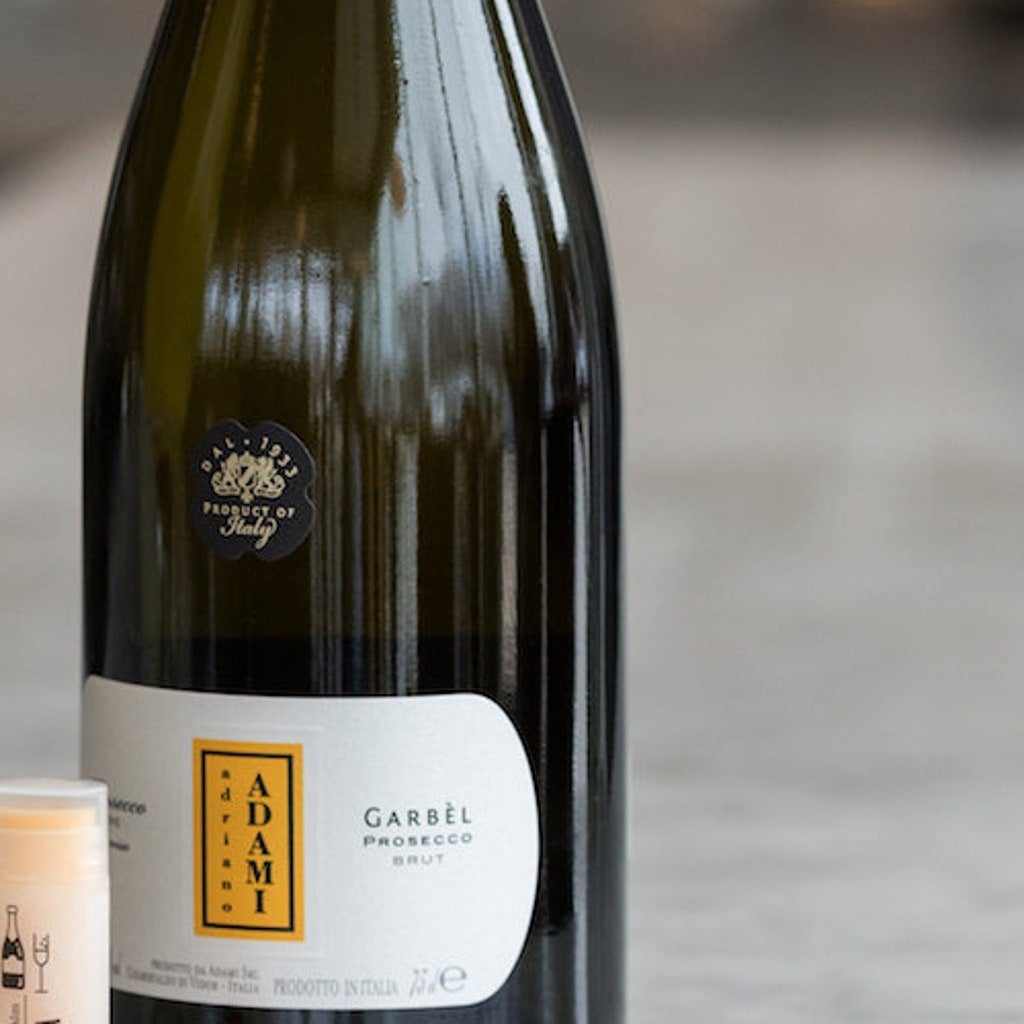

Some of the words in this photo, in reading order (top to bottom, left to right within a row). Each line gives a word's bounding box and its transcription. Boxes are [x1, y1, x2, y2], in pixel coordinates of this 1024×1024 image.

[202, 501, 271, 517] PRODUCT
[276, 507, 295, 518] OF
[219, 515, 278, 550] Italy
[363, 802, 472, 829] GARBÈL
[220, 769, 233, 913] adriano
[245, 773, 274, 914] ADAMI
[363, 833, 473, 848] PROSECCO
[392, 854, 444, 866] BRUT
[273, 977, 340, 997] PRODOTTO
